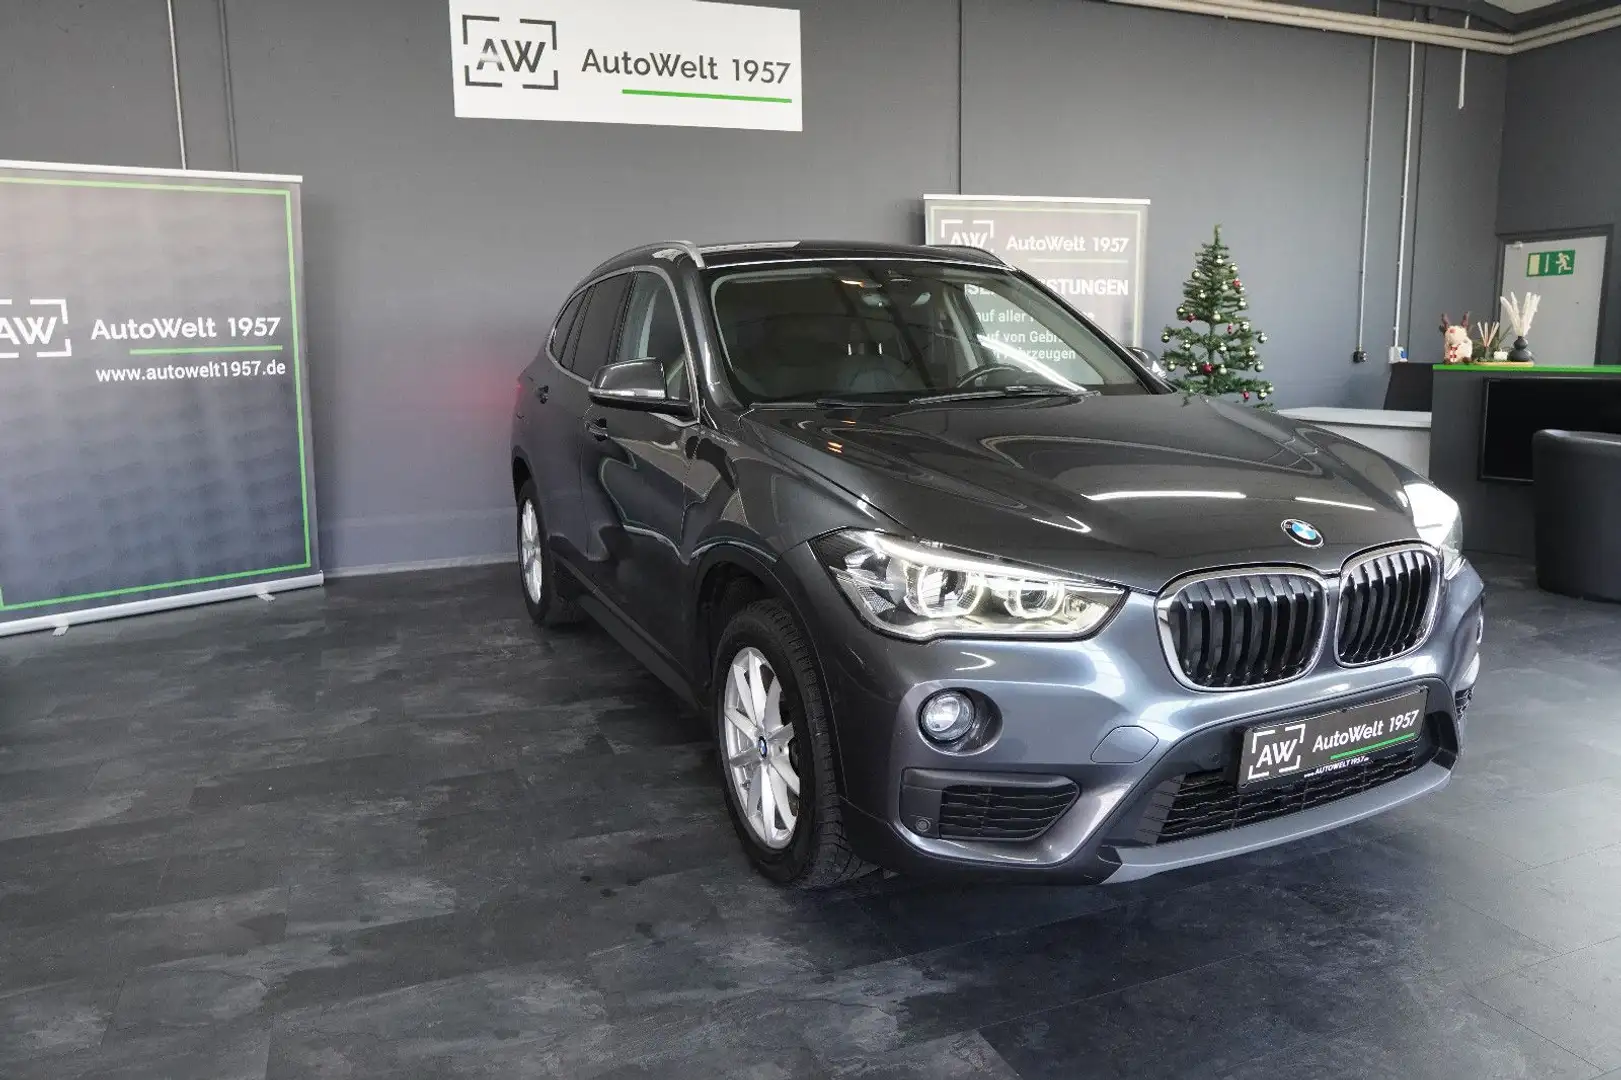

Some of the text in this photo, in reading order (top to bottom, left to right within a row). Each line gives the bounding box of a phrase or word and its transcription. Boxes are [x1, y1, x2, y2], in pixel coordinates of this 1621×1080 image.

[476, 38, 547, 73] AW
[581, 48, 792, 84] AutoWelt 1957
[1006, 235, 1130, 253] AutoWelt 1957
[1041, 278, 1128, 296] STUNGEN
[998, 309, 1028, 322] aller
[90, 317, 281, 341] AutoWelt 1957
[1003, 333, 1026, 343] von
[96, 359, 286, 382] www.autowelt1957.de
[1312, 709, 1420, 753] AutoWelt 1957
[1256, 738, 1298, 768] AW
